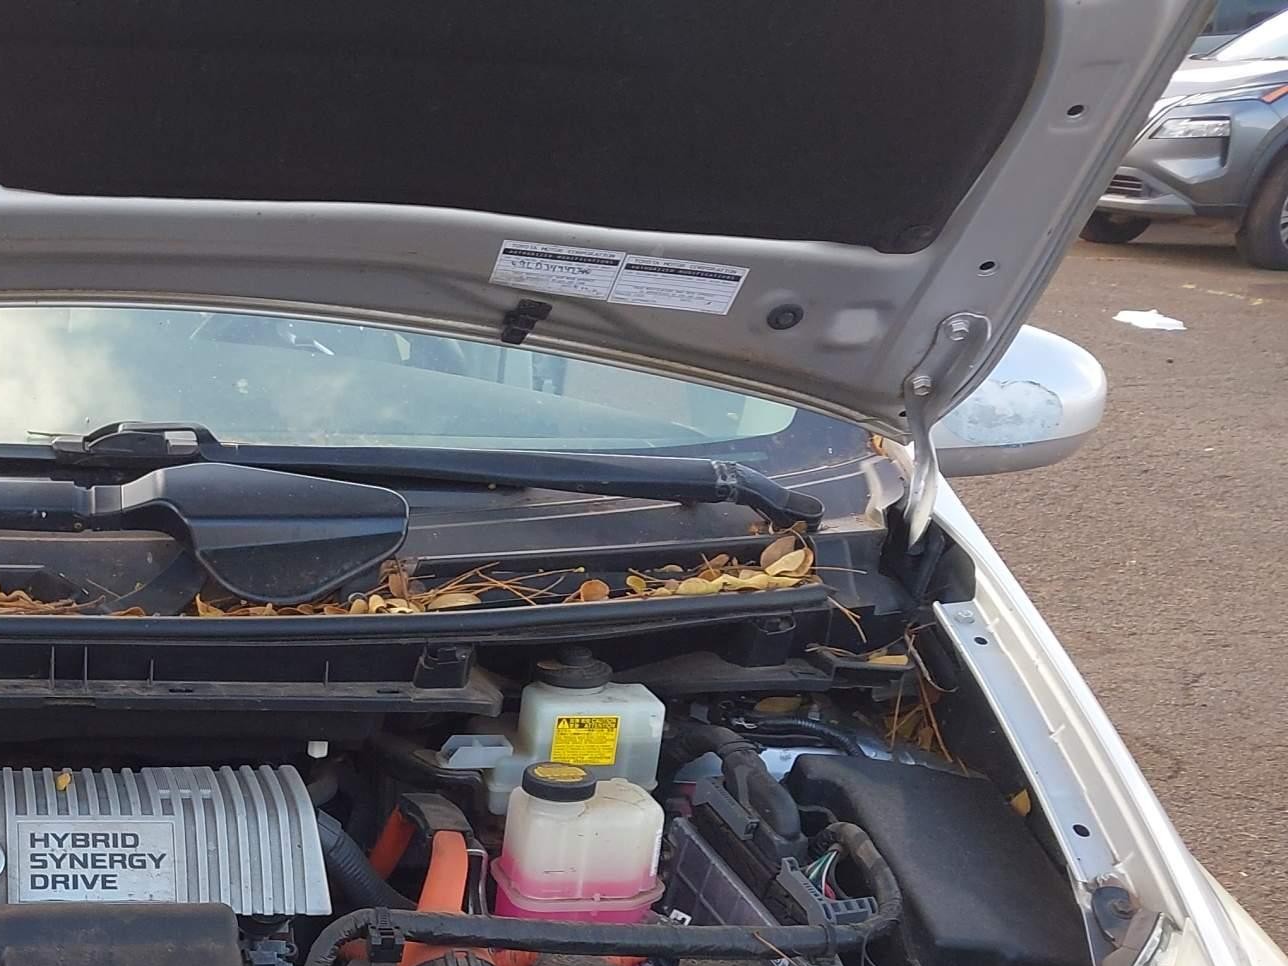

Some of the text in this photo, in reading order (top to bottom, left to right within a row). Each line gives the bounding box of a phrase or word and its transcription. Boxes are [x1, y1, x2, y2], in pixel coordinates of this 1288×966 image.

[30, 832, 139, 849] HYBRID
[30, 853, 167, 869] SYNERGY
[30, 874, 118, 890] DRIVE
